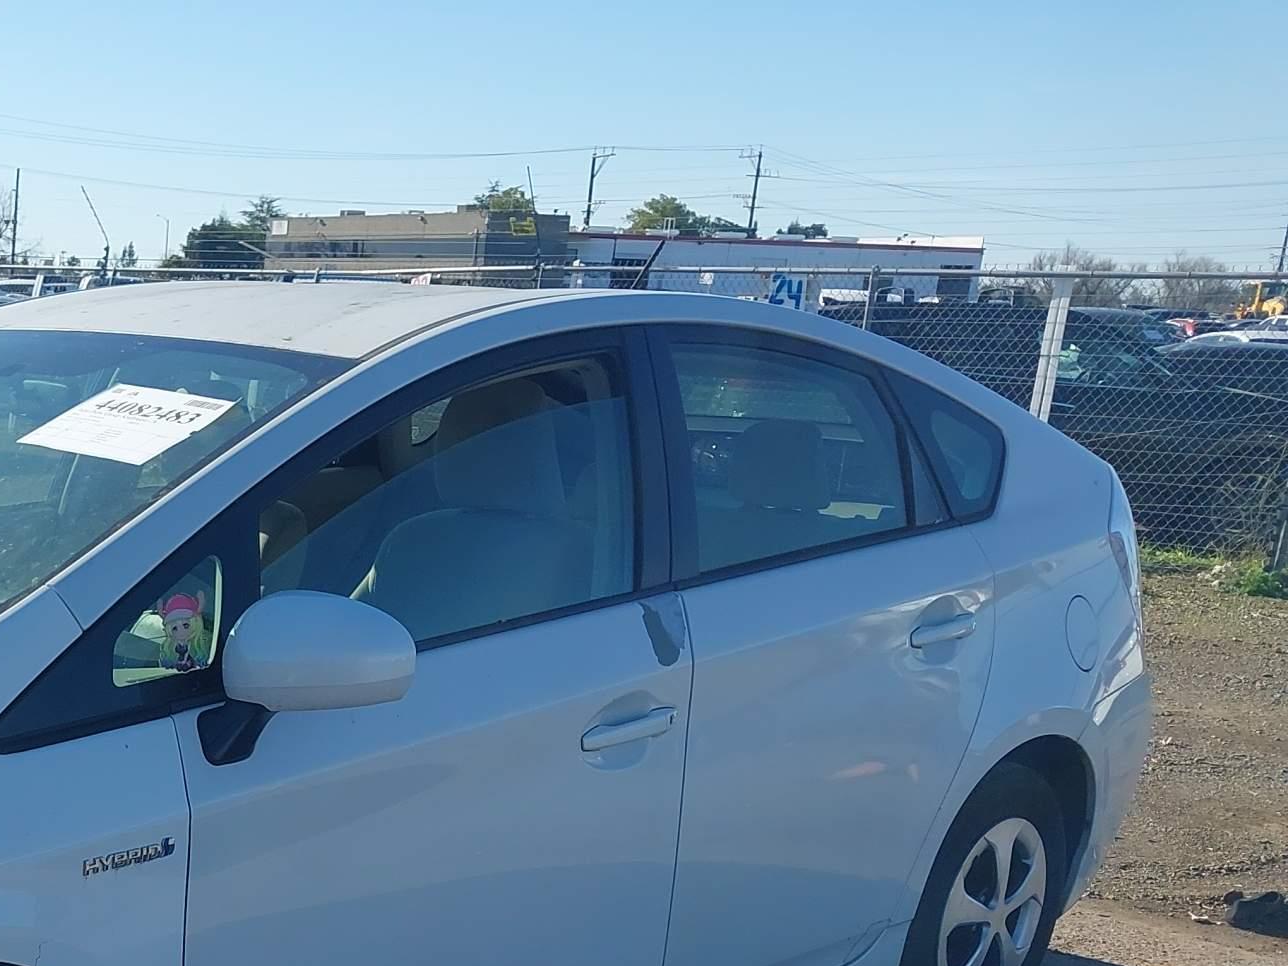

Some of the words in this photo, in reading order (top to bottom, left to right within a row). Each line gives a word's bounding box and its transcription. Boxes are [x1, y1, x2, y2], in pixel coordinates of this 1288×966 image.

[768, 274, 803, 309] 24
[96, 399, 201, 424] 44082483
[83, 844, 161, 876] HYBRID
